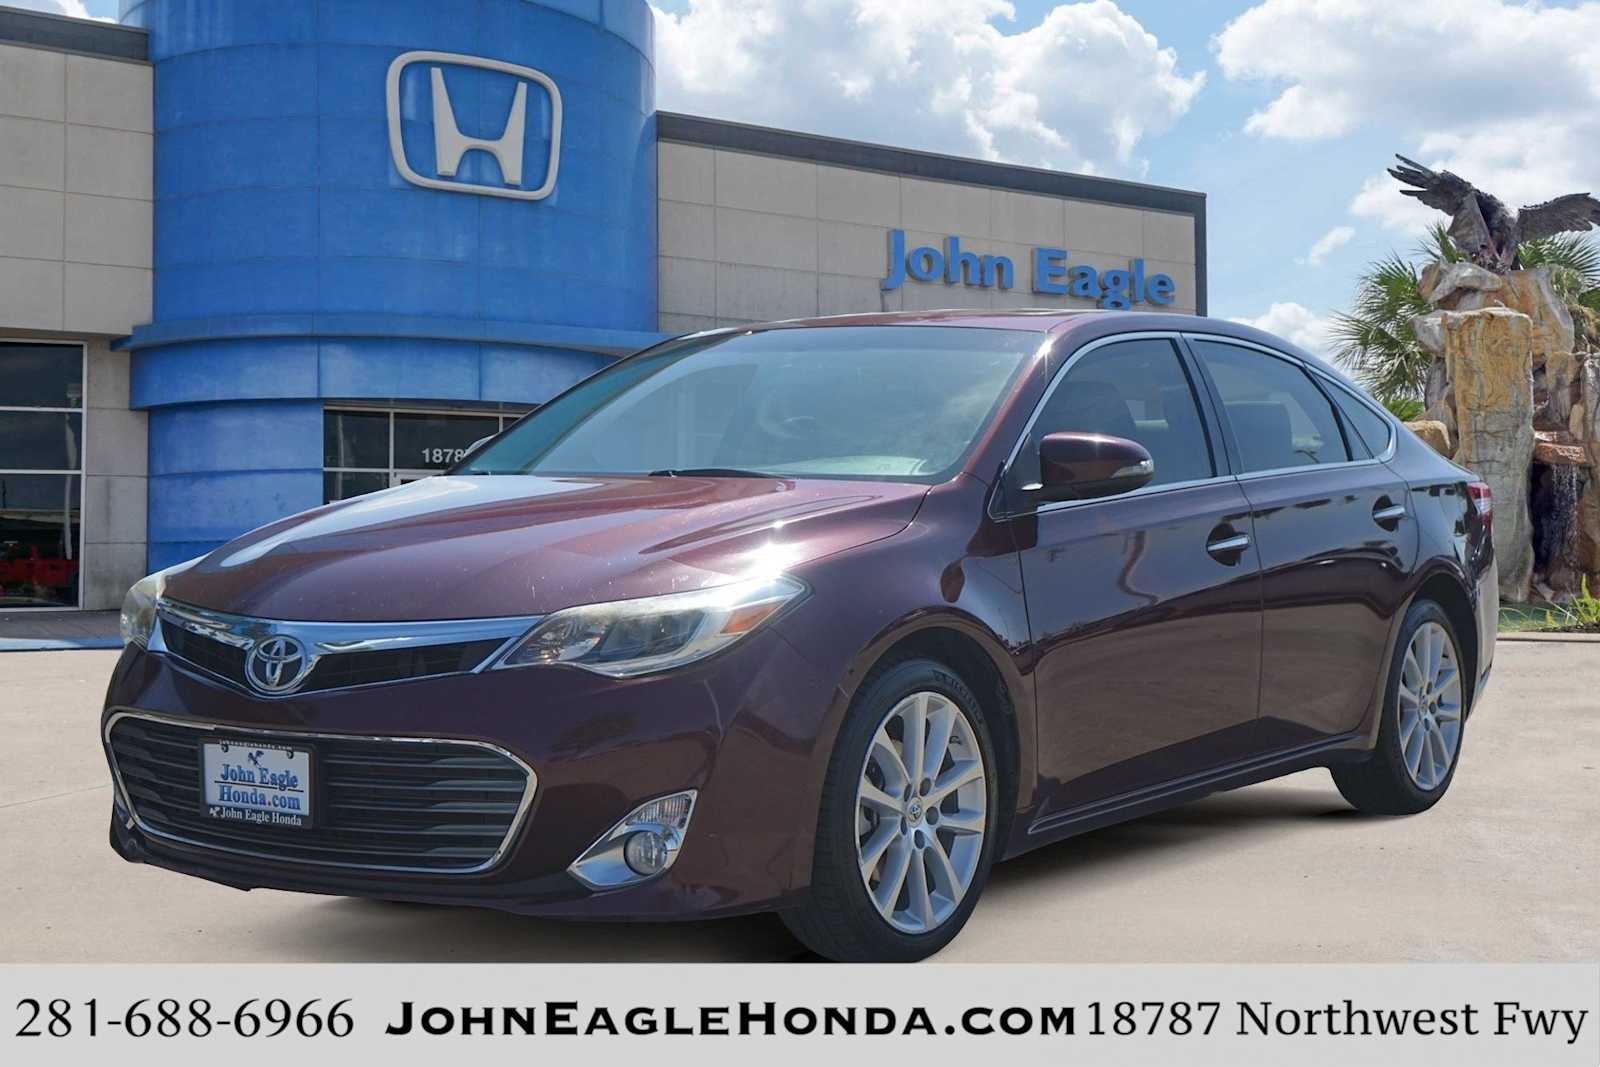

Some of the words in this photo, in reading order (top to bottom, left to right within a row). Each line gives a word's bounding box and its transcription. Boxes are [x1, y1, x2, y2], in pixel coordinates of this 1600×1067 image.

[880, 229, 1013, 292] John
[1031, 247, 1175, 311] Eagle
[421, 448, 468, 463] 1878
[220, 763, 256, 784] John
[259, 767, 299, 791] Eagle
[218, 784, 302, 810] Honda.com
[220, 807, 243, 819] John
[245, 809, 270, 824] Eagle
[272, 812, 302, 826] Honda
